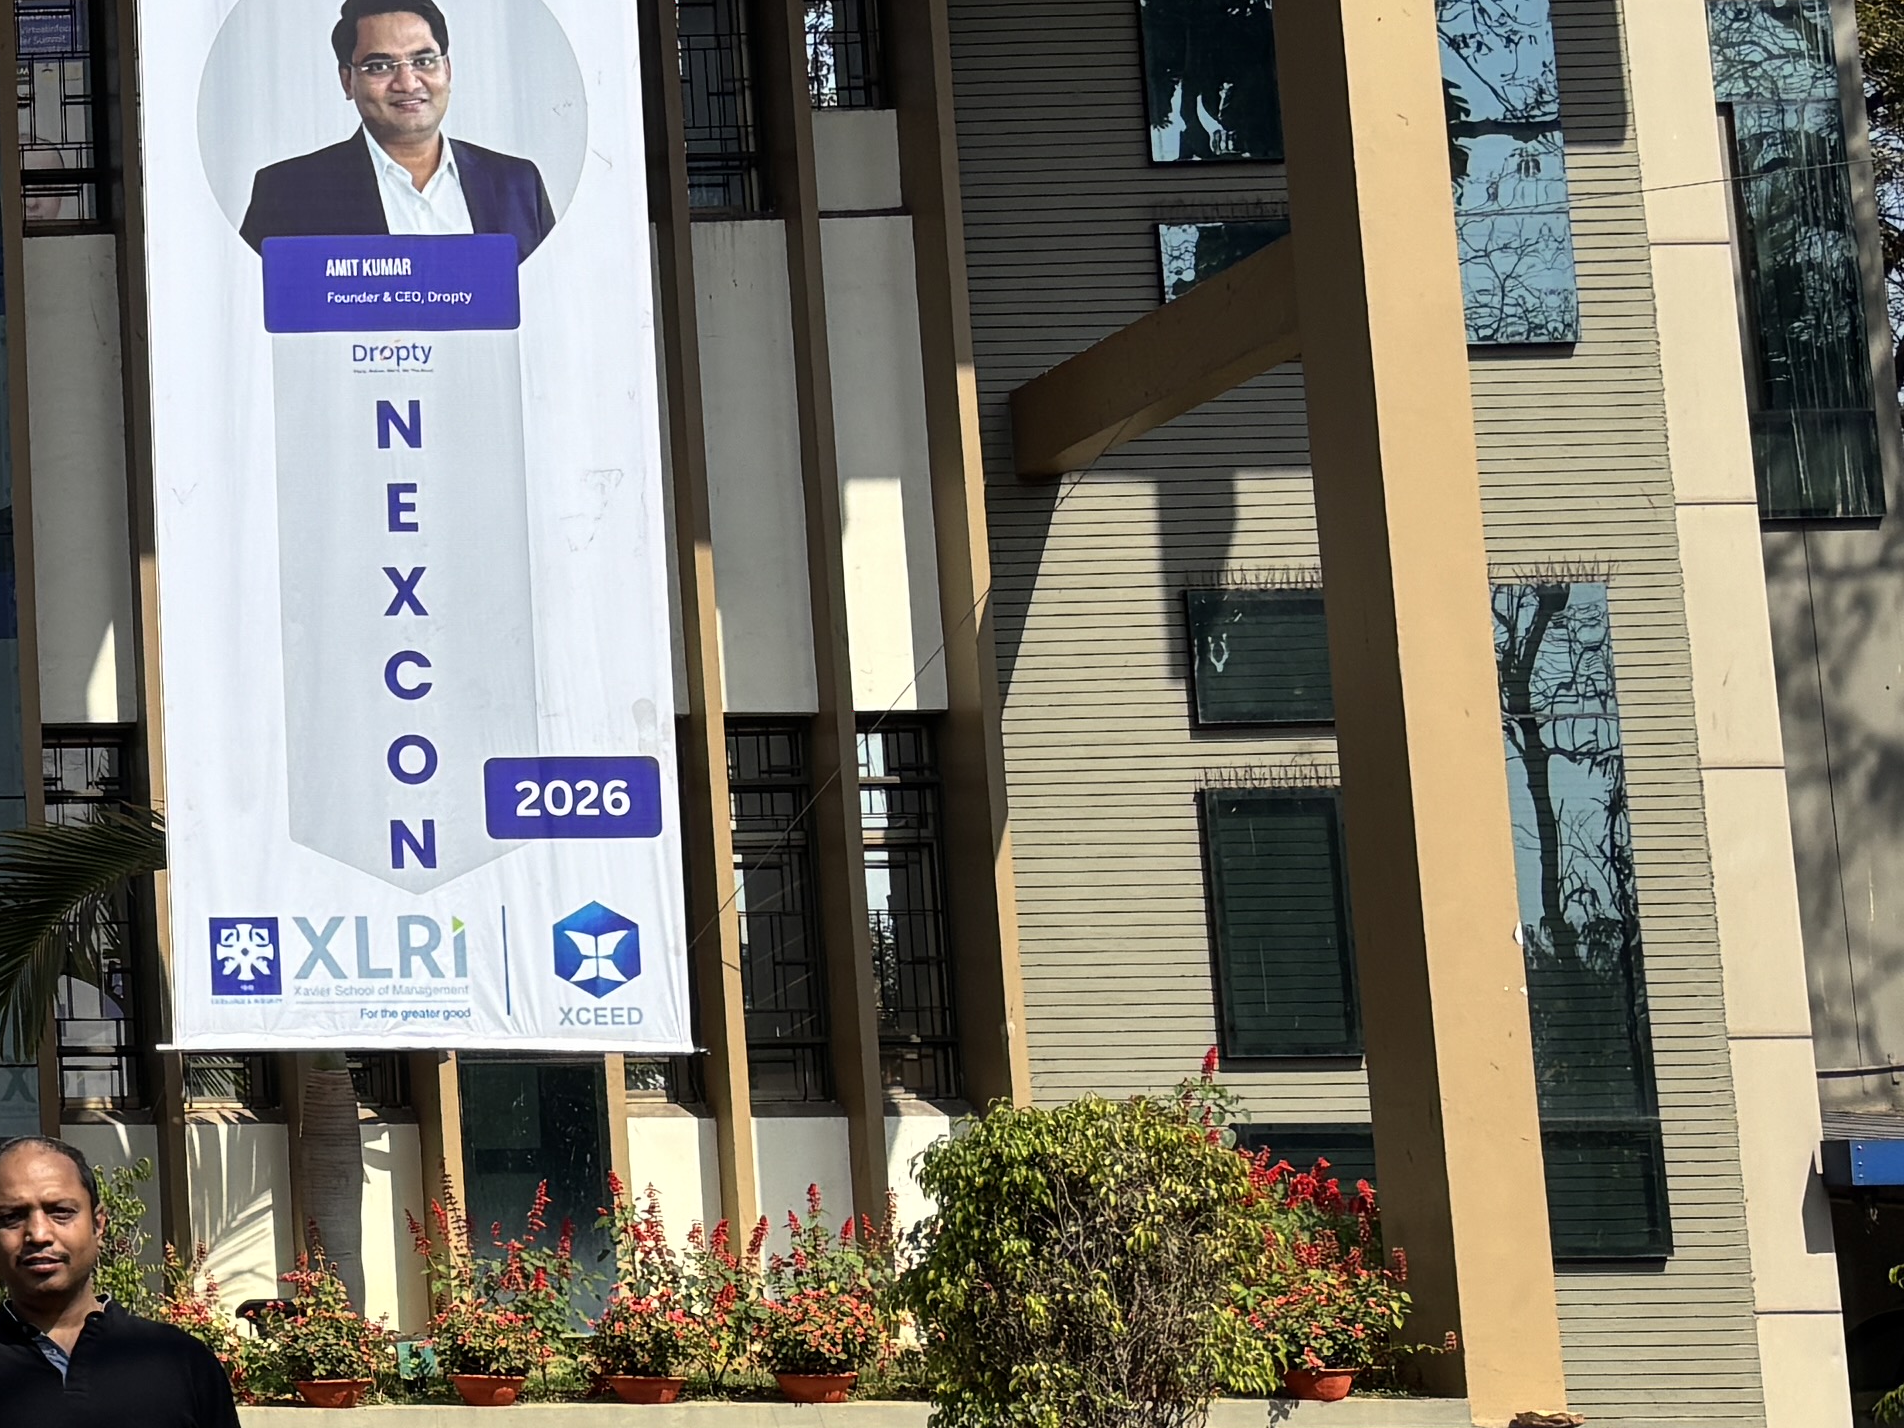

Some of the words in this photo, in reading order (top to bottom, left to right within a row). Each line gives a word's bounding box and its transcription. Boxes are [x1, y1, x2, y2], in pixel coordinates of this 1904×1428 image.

[325, 258, 359, 277] AMIT
[362, 257, 412, 276] KUMAR
[327, 291, 380, 304] Founder
[382, 291, 392, 303] &
[395, 290, 425, 304] CEO,
[427, 290, 473, 305] Dropty
[352, 341, 433, 367] Dropty
[375, 399, 438, 870] NEXCON
[514, 778, 631, 817] 2026
[334, 984, 375, 996] School
[558, 1006, 644, 1026] XCEED
